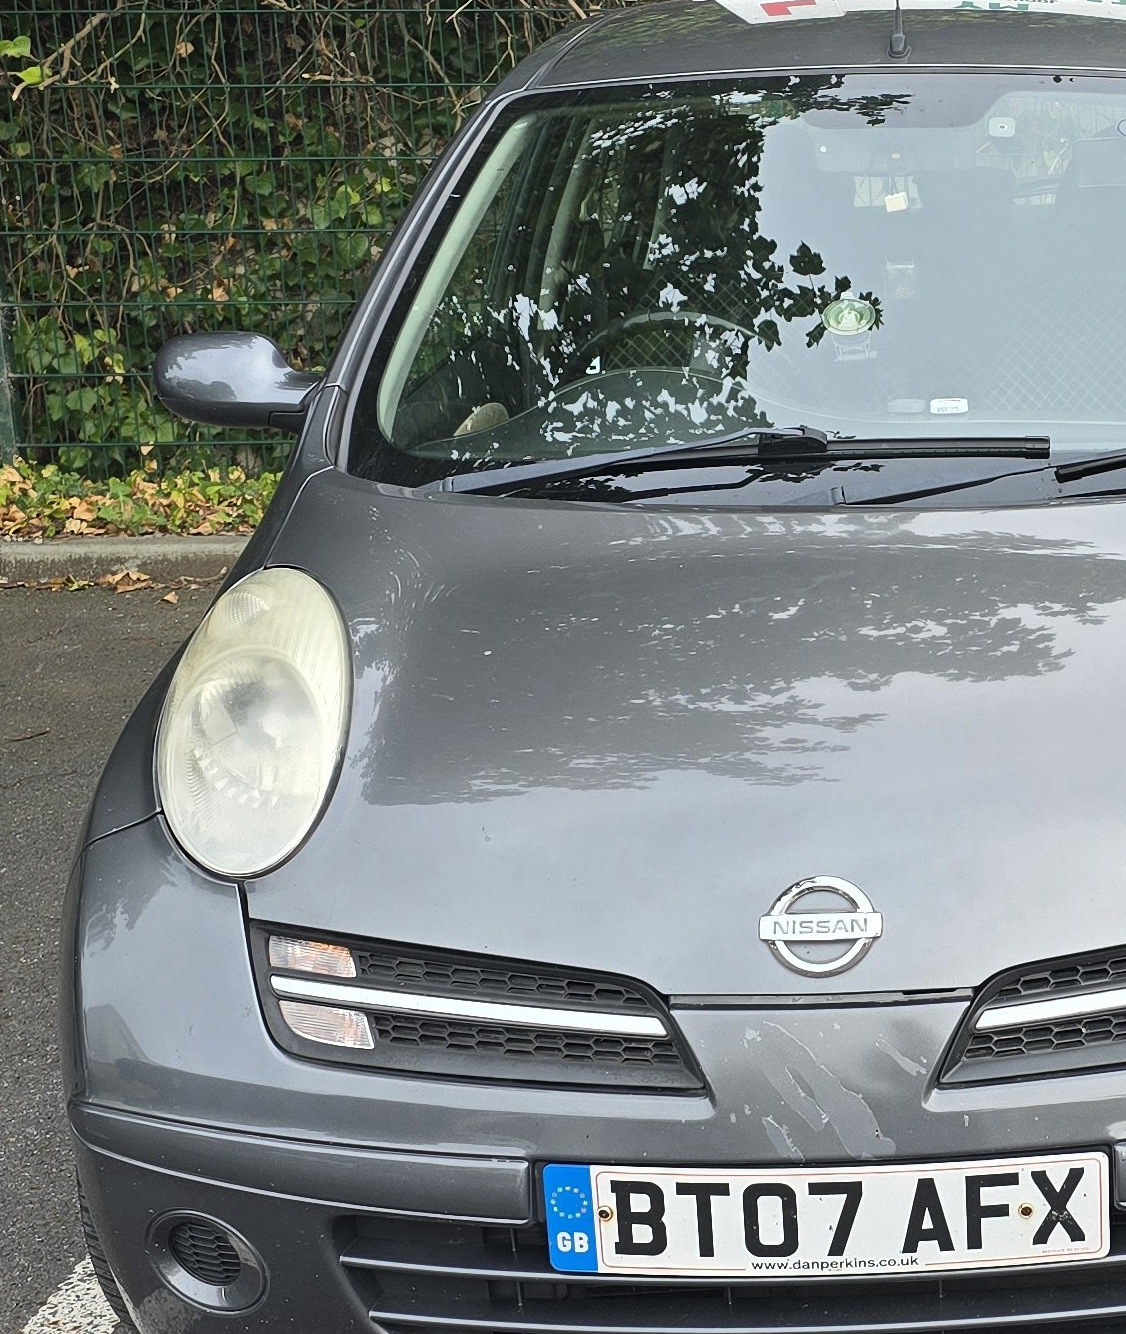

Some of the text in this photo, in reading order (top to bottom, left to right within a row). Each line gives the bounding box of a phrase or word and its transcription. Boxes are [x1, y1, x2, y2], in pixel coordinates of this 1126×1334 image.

[773, 917, 868, 934] NISSAN
[610, 1166, 1086, 1258] BT07 AFX
[556, 1231, 589, 1253] GB
[751, 1256, 919, 1271] www.danperkins.co.uk
